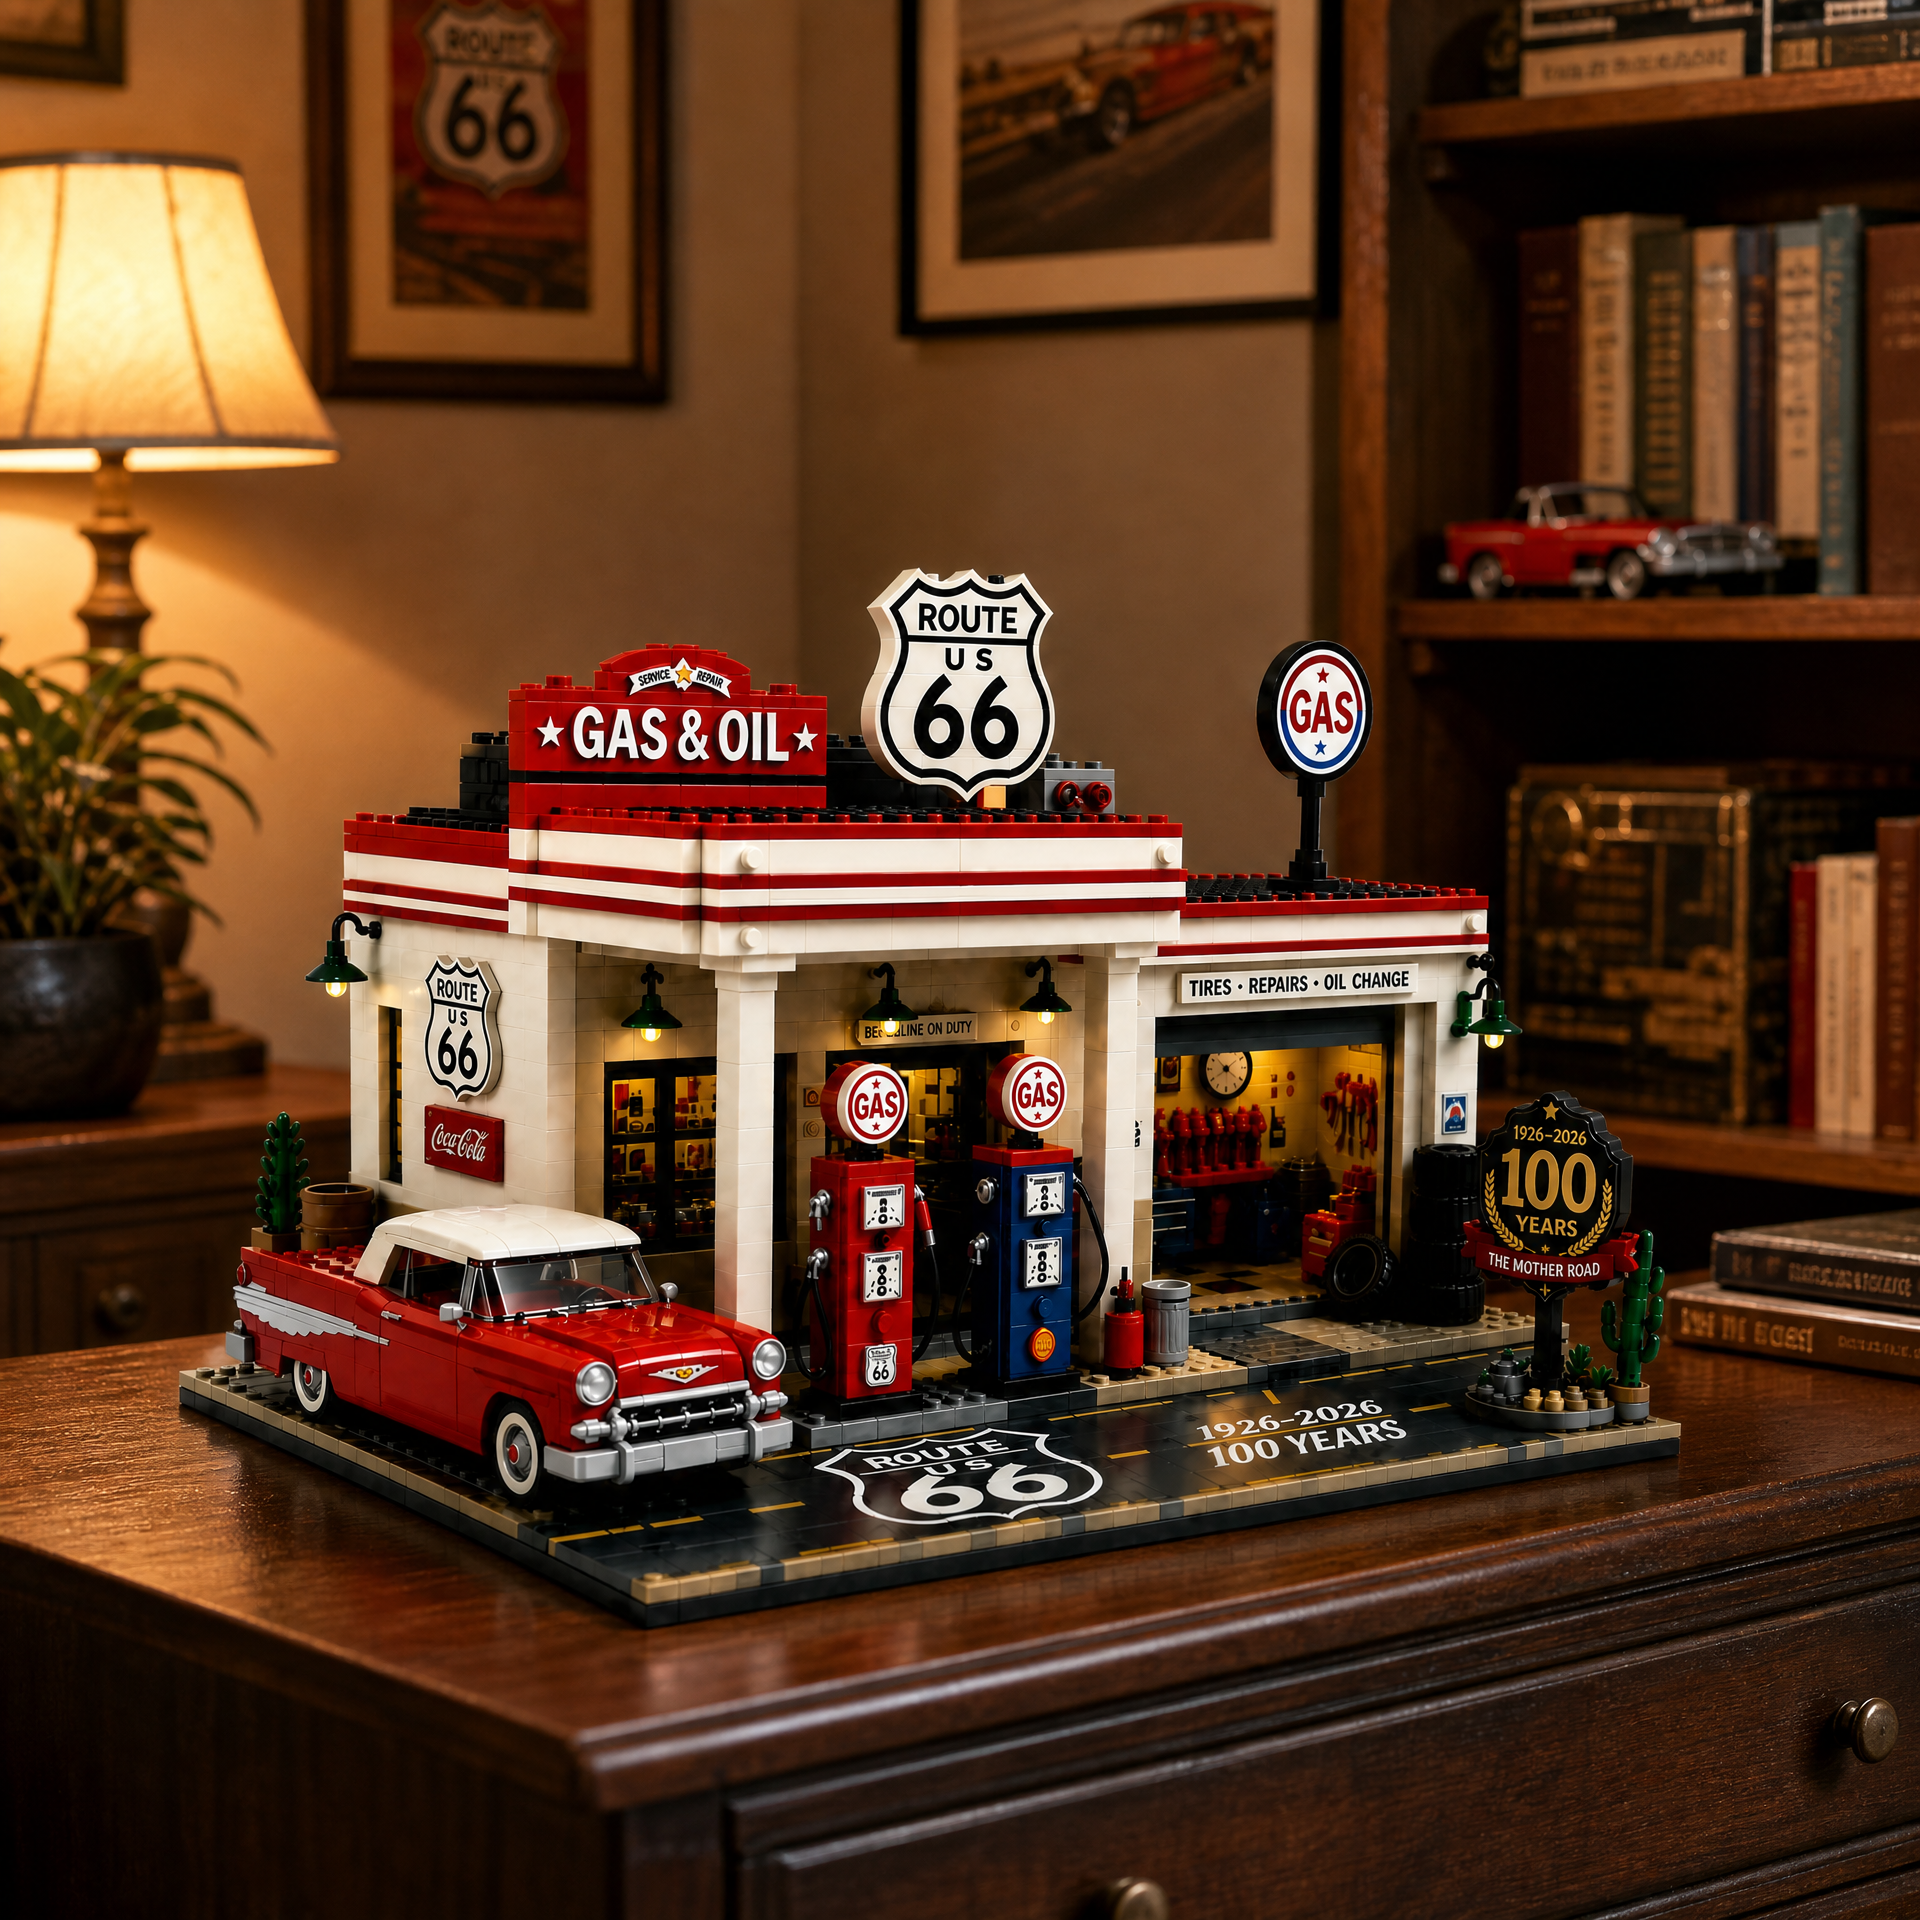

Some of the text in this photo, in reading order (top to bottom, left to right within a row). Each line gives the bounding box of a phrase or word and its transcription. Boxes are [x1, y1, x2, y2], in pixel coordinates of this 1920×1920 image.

[446, 75, 536, 161] 66
[918, 602, 1018, 635] ROUTE
[638, 669, 724, 689] SERVICE REPAIR
[913, 673, 1020, 760] 66
[1289, 689, 1354, 735] GAS
[573, 706, 790, 762] GAS & OIL
[437, 977, 478, 1003] ROUTE
[1189, 970, 1410, 997] TIRES REPAIRS OIL CHANGE
[927, 1022, 943, 1036] ON
[946, 1020, 973, 1035] DUTY
[438, 1026, 478, 1080] 66
[854, 1090, 898, 1121] GAS
[1017, 1080, 1059, 1109] GAS
[431, 1123, 490, 1162] Coca-Cola
[1501, 1148, 1597, 1214] 100
[1515, 1214, 1578, 1238] YEARS
[1488, 1251, 1601, 1278] THE MOTHER ROAD
[872, 1364, 890, 1381] 66
[862, 1439, 1010, 1470] ROUTE
[1206, 1419, 1408, 1468] 100 YEARS
[900, 1462, 1069, 1515] 66
